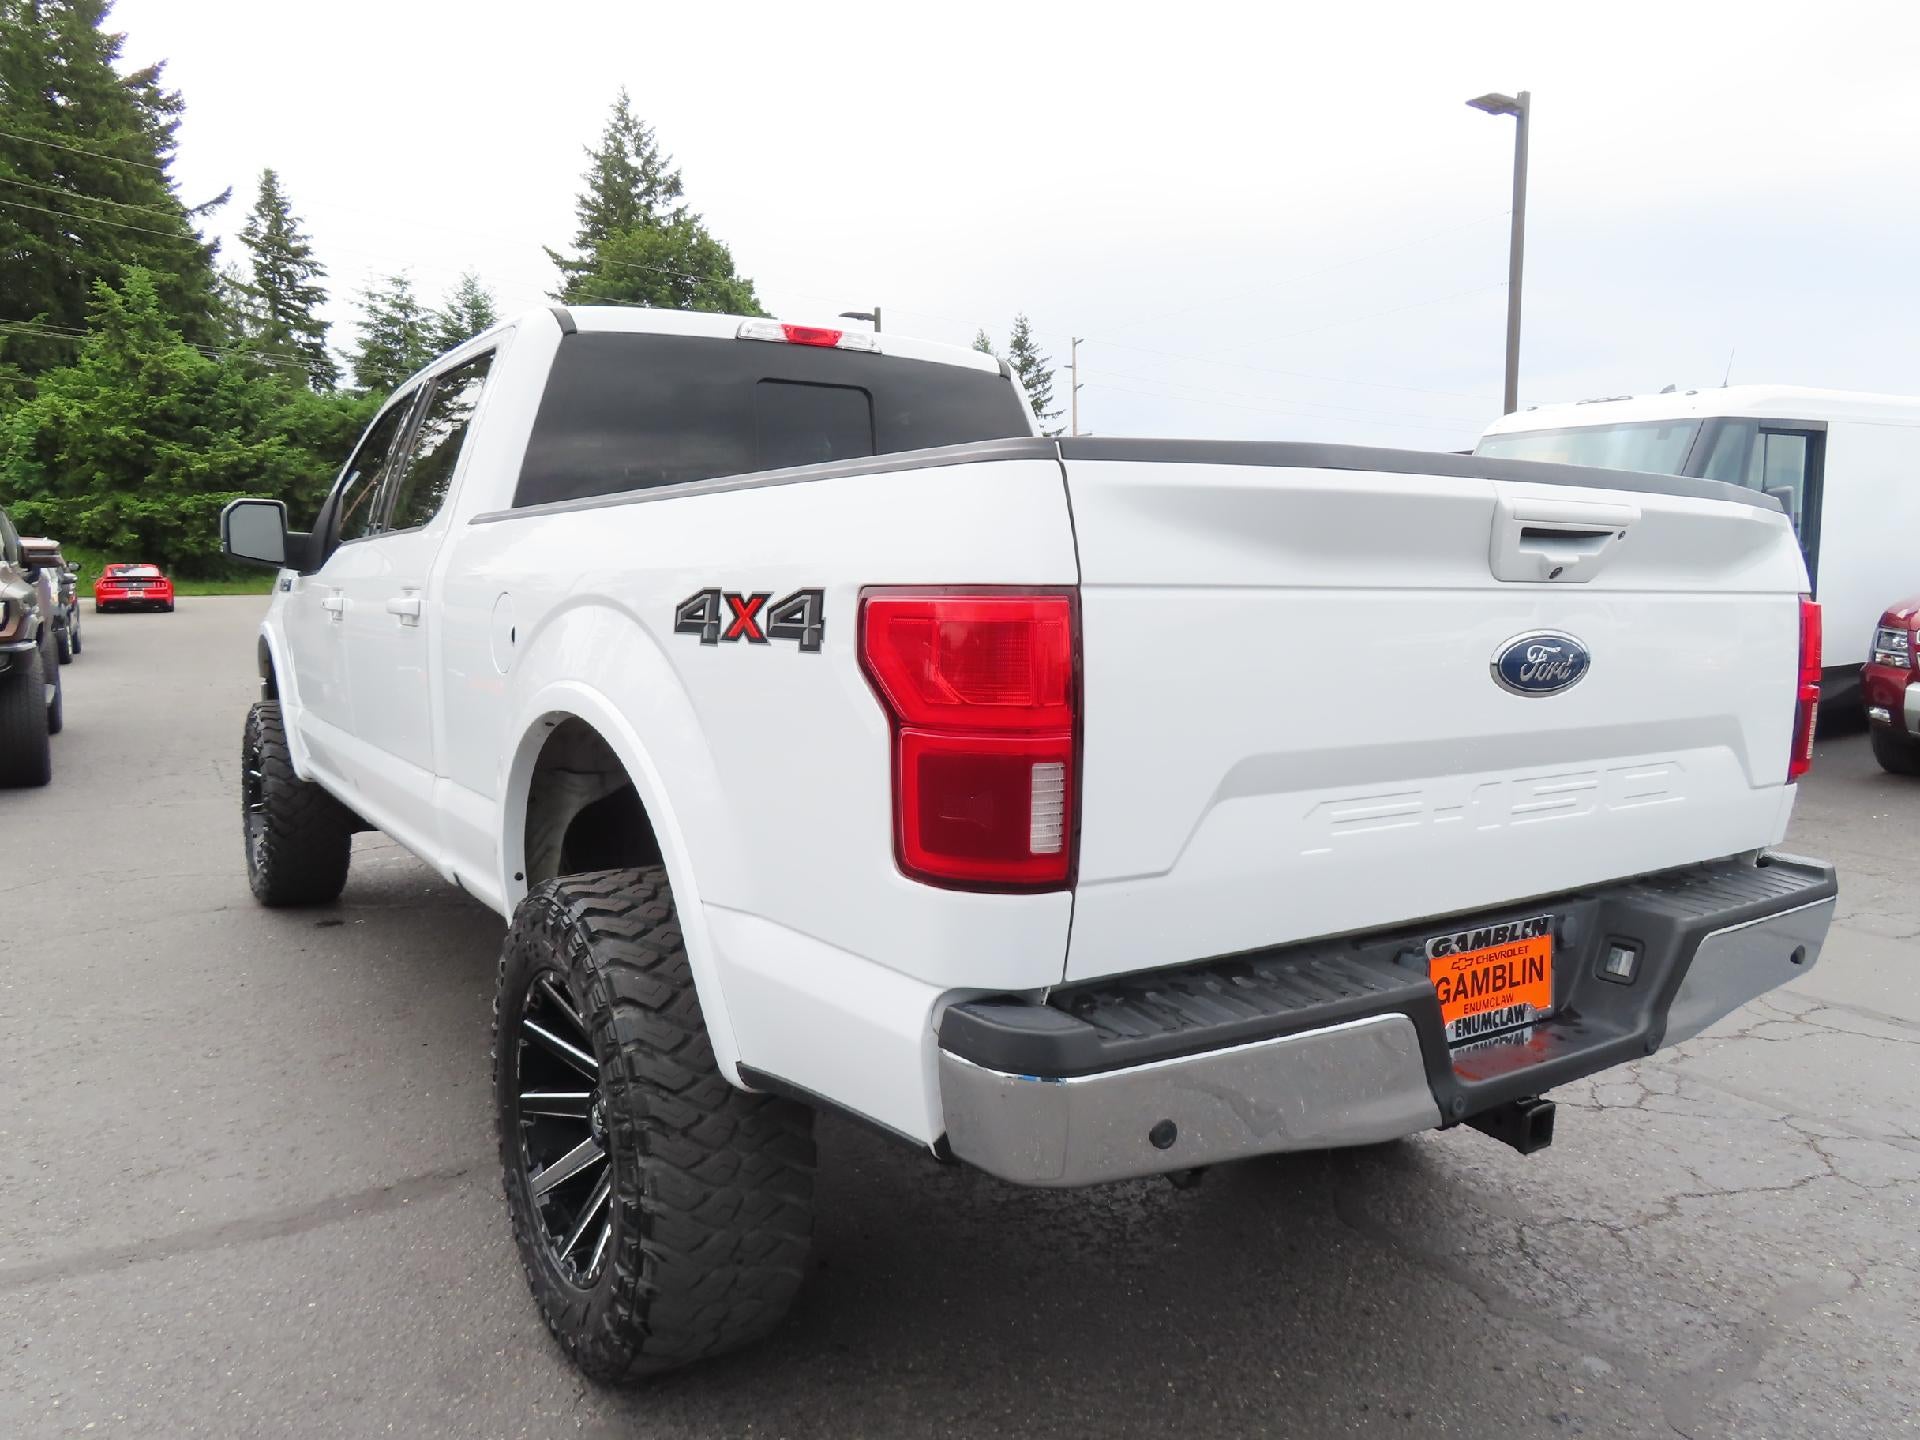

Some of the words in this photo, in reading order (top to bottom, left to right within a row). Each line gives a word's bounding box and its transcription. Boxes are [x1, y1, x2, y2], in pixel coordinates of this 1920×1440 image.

[1520, 644, 1575, 682] Ford
[1475, 945, 1529, 965] CHEVROLET
[1435, 955, 1545, 1005] GAMBLIN
[1455, 1003, 1526, 1038] ENUMCLAW
[1463, 993, 1514, 1015] ENUMCLAW
